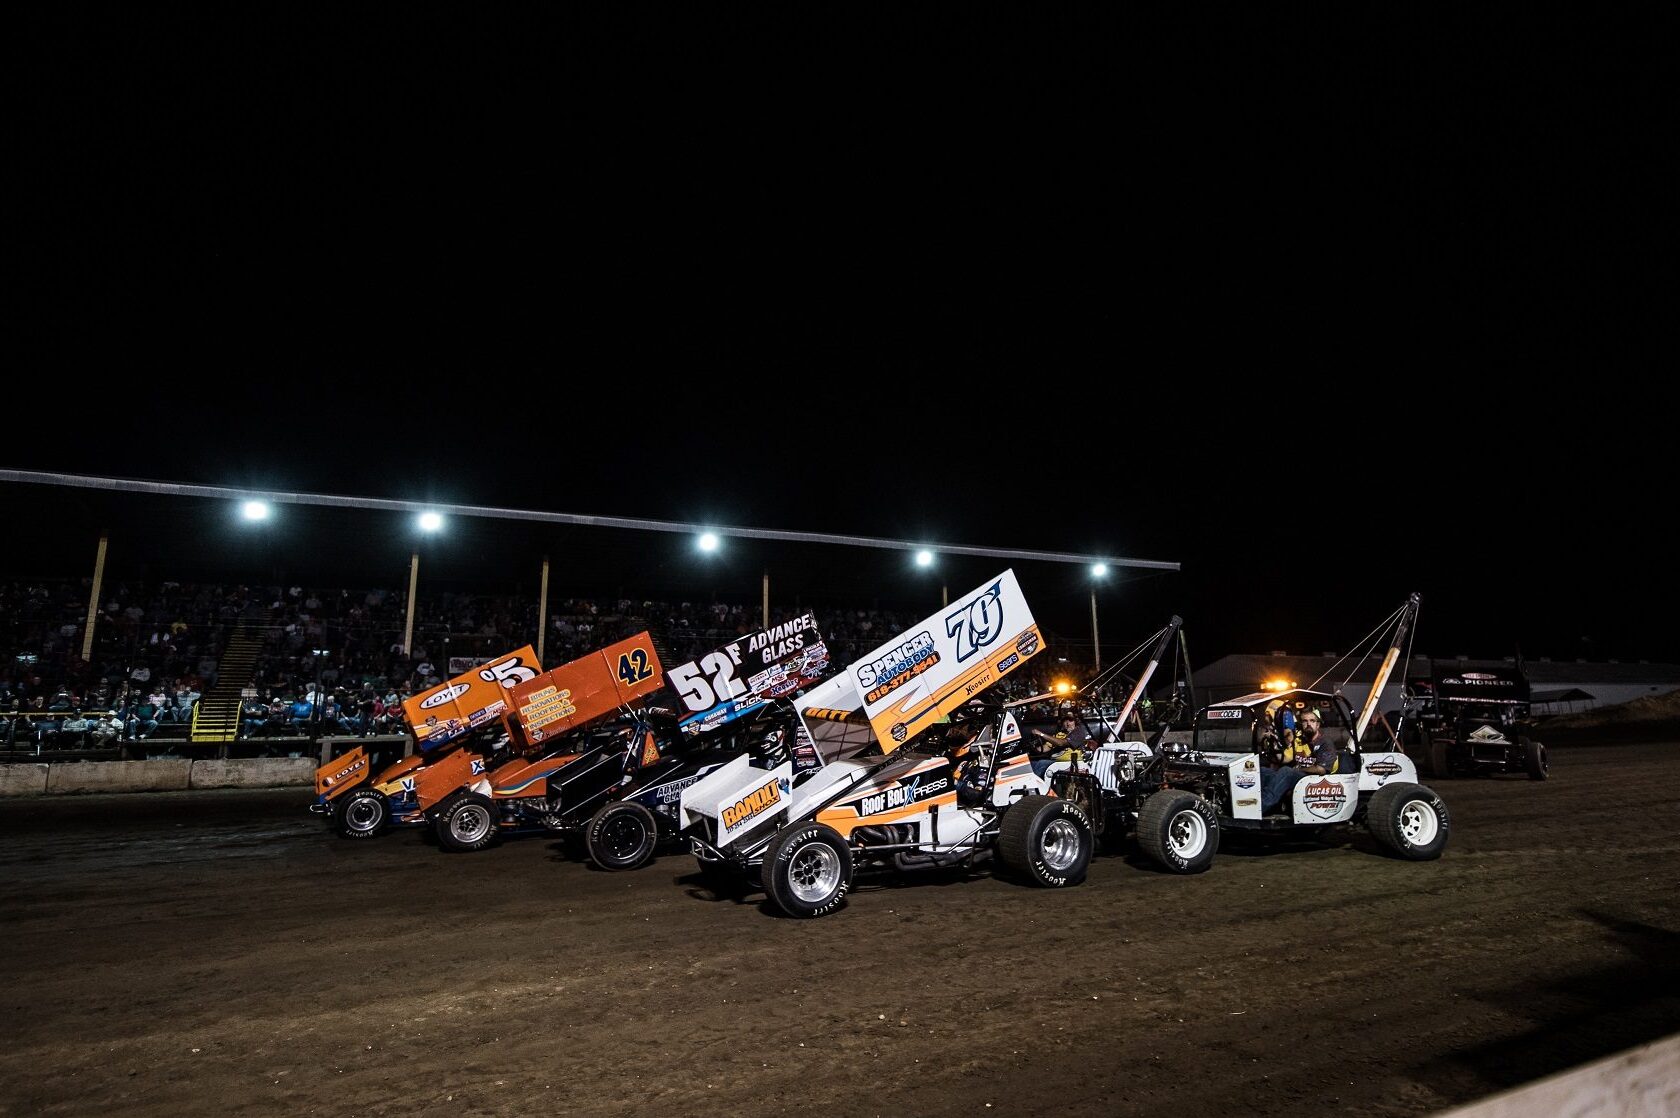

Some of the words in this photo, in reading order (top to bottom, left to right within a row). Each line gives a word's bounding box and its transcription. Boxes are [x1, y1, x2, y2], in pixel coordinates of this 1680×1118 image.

[749, 614, 810, 653] ADVANCE
[945, 578, 1003, 663] 79
[762, 634, 804, 663] GLASS
[857, 631, 934, 688] SPENCER
[618, 648, 654, 687] 42
[877, 643, 934, 685] AUTOBODY
[771, 678, 798, 696] Hoosier
[965, 674, 990, 696] Hoosier
[336, 760, 366, 779] LOYET
[722, 777, 780, 830] BANDIT
[754, 795, 779, 815] SHOX
[1308, 787, 1330, 796] LUCAS
[1331, 786, 1342, 795] OIL
[1062, 804, 1091, 829] Hoosier
[1193, 800, 1216, 829] Hoosier
[779, 829, 818, 861] Hoosier
[1036, 861, 1066, 886] Hoosier
